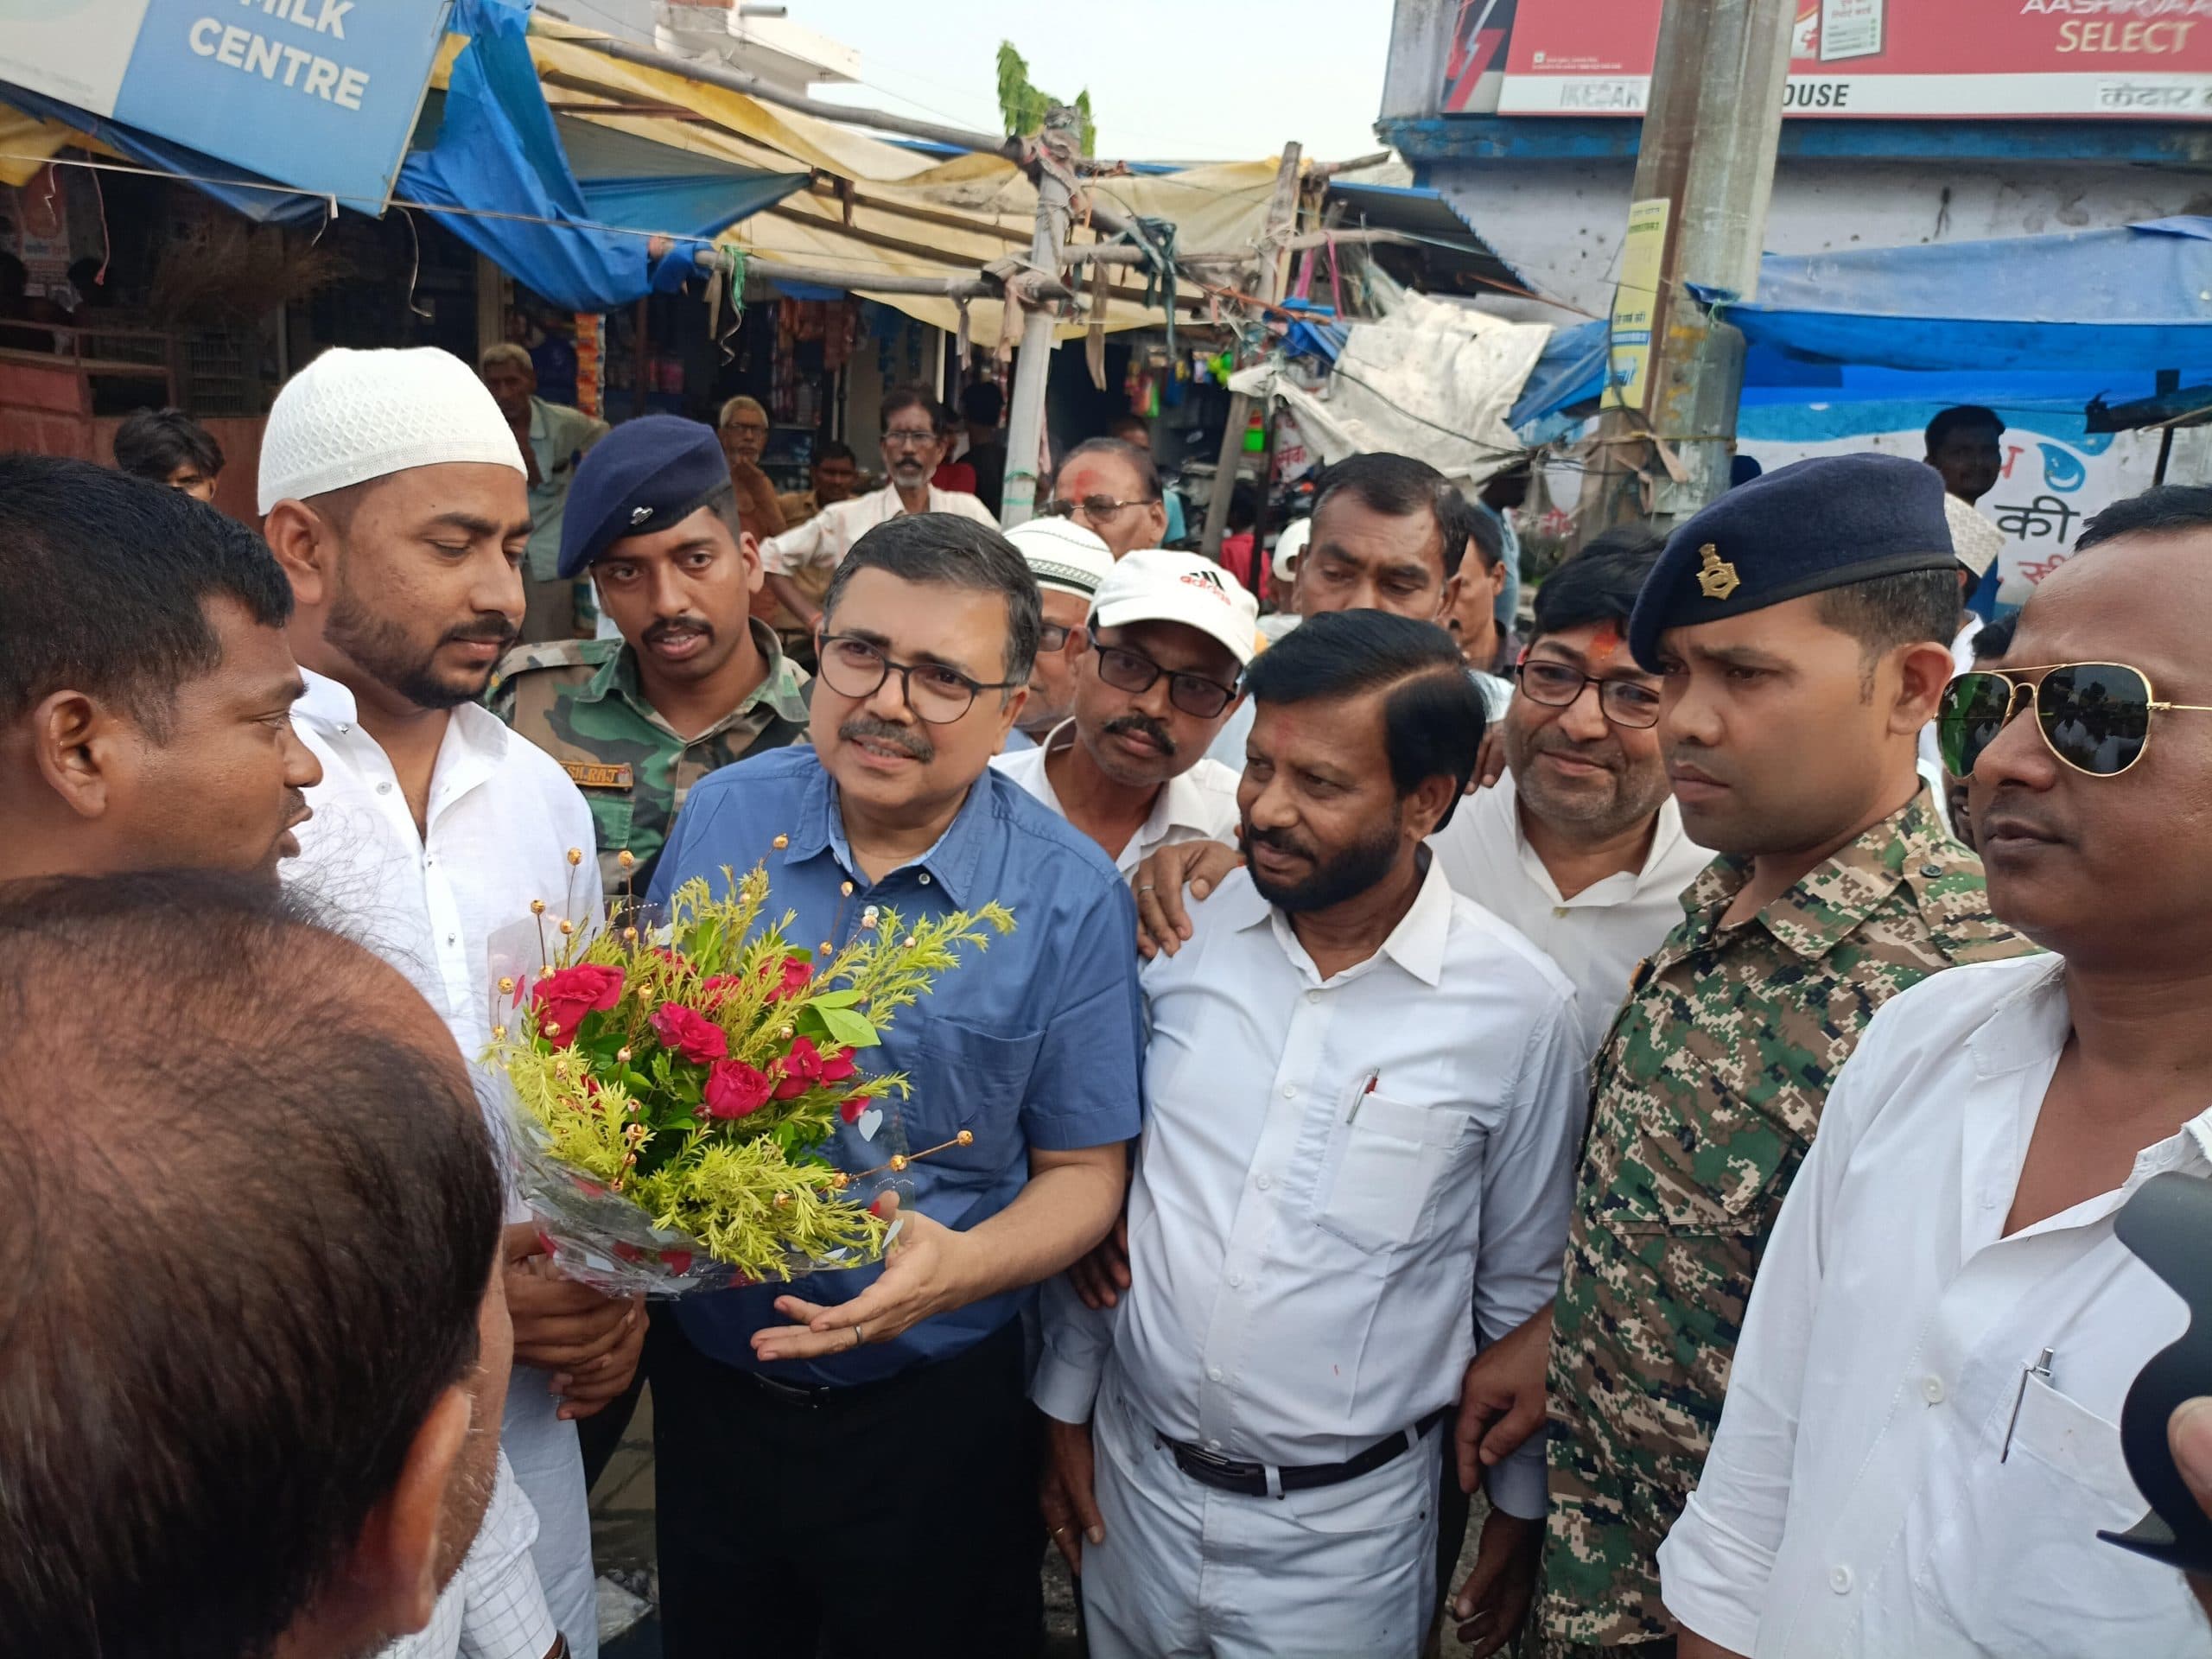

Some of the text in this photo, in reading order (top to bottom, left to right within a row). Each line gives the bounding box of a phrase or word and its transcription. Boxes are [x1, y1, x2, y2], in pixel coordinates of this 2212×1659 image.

[2055, 19, 2197, 54] SELECT
[189, 16, 370, 111] CENTRE
[1993, 495, 2081, 544] की
[1180, 575, 1231, 605] adidas
